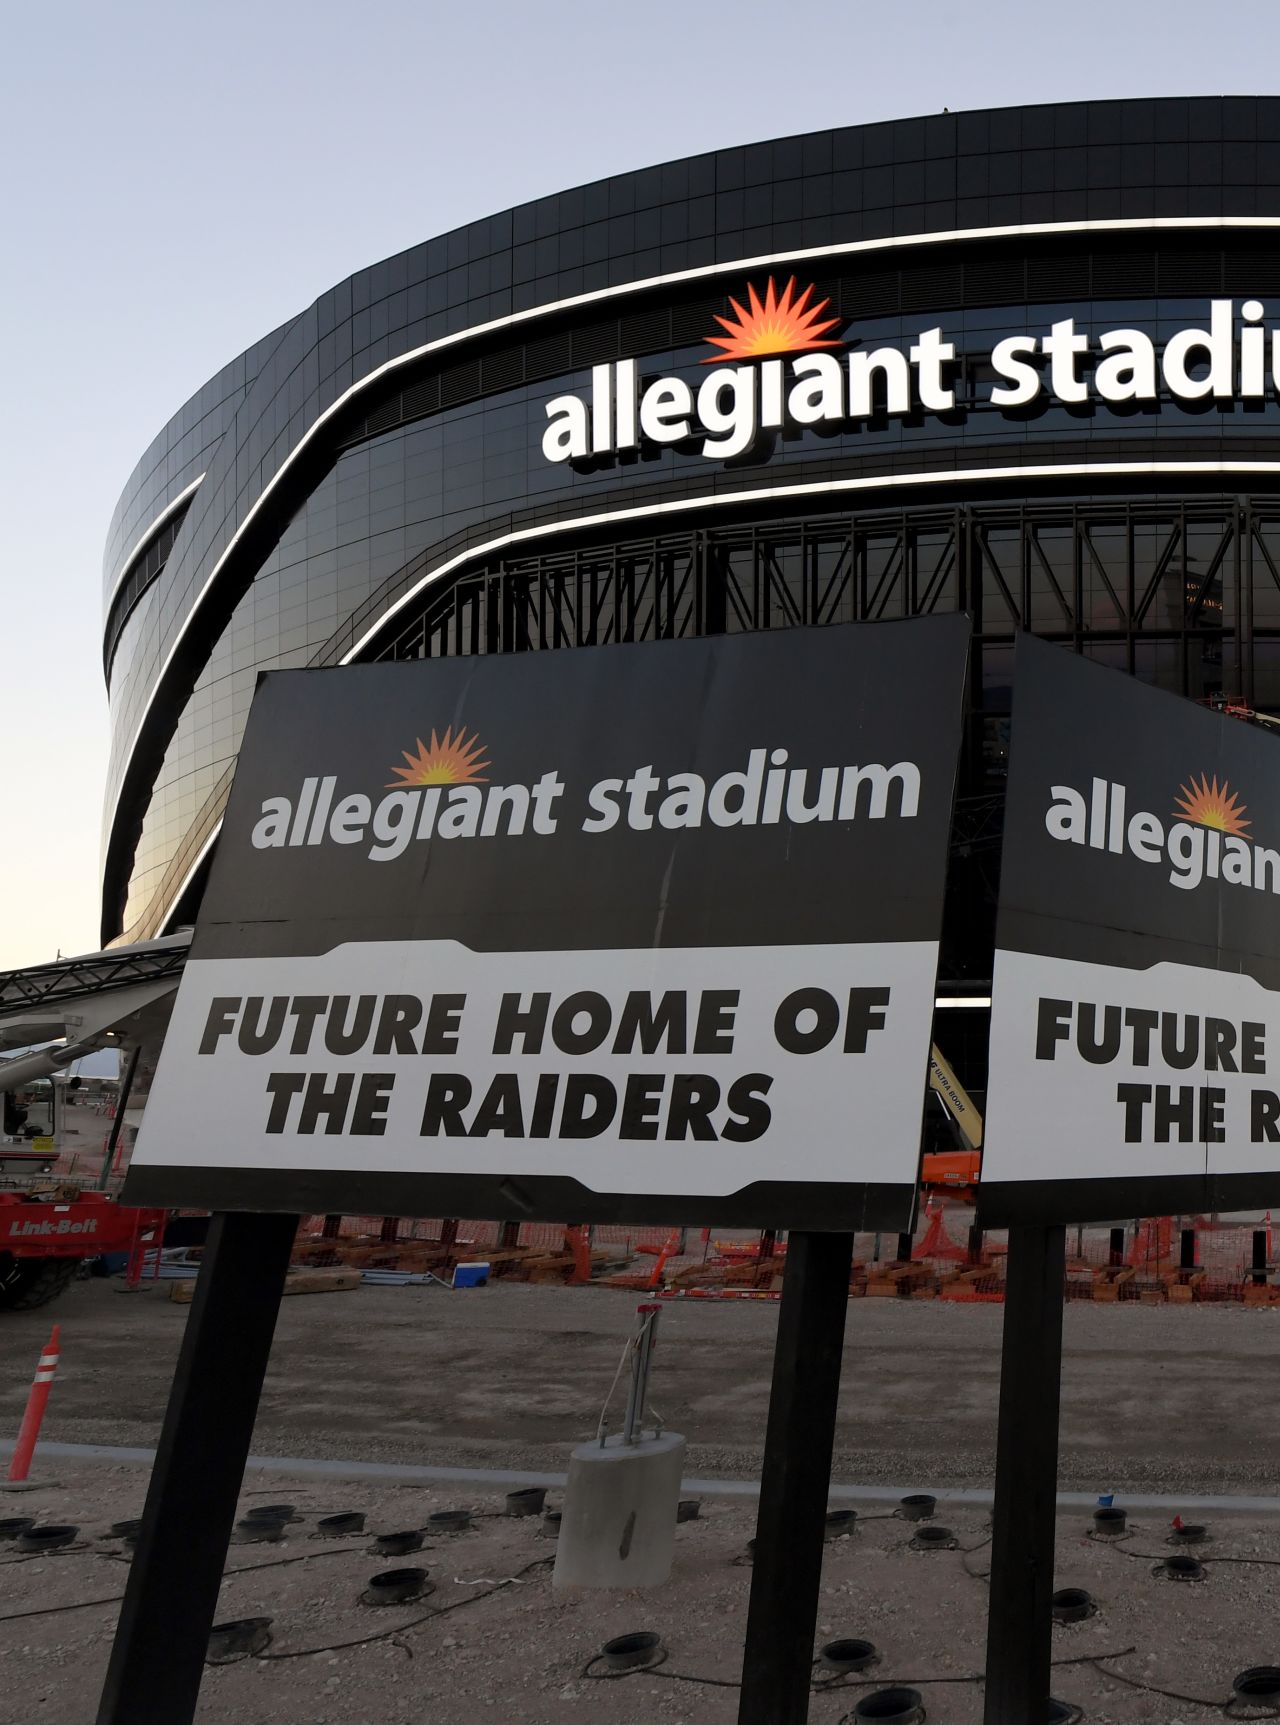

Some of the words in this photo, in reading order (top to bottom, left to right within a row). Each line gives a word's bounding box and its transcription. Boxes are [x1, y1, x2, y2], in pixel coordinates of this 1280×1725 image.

[543, 328, 952, 461] allegiant
[252, 771, 564, 861] allegiant
[582, 749, 920, 834] stadium
[199, 994, 467, 1055] FUTURE
[492, 990, 740, 1054] HOME
[774, 987, 890, 1054] OF
[1036, 998, 1265, 1074] FUTURE
[266, 1073, 396, 1135] THE
[420, 1073, 774, 1142] RAIDERS
[935, 1067, 951, 1091] ULTRA
[949, 1091, 965, 1112] BOOM
[1117, 1083, 1225, 1144] THE
[9, 1219, 97, 1236] Link-Belt
